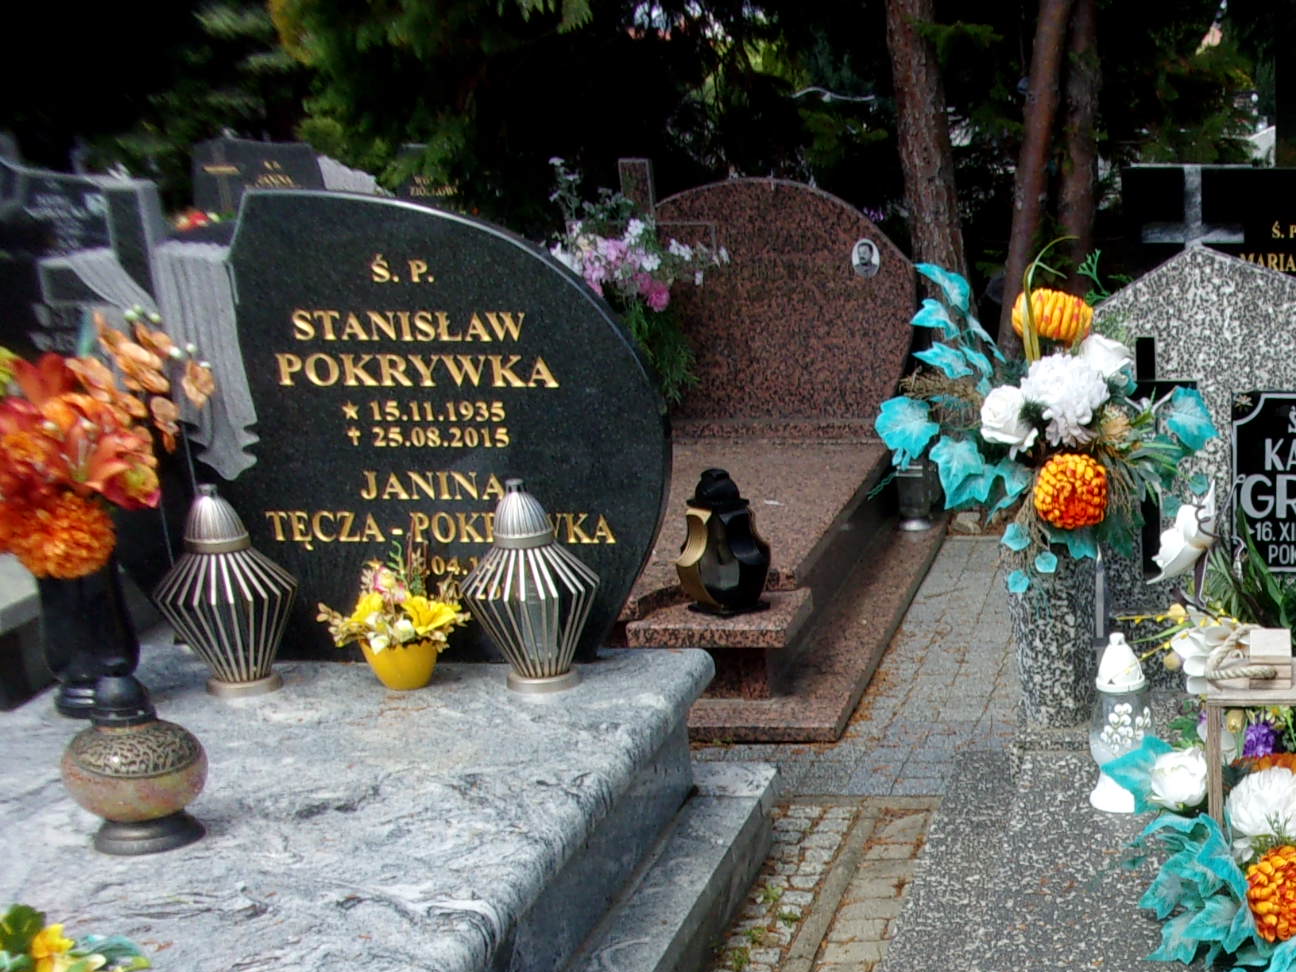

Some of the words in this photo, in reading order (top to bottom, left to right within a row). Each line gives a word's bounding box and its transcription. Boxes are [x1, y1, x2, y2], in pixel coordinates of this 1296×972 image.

[370, 253, 399, 283] Ś.
[409, 260, 435, 283] P.
[291, 309, 526, 343] STANISŁAW
[274, 353, 560, 389] POKRYWKA
[371, 400, 506, 423] 15.11.1935
[371, 426, 511, 449] 25.08.2015
[360, 470, 506, 501] JANINA
[264, 510, 386, 552] TĘCZA
